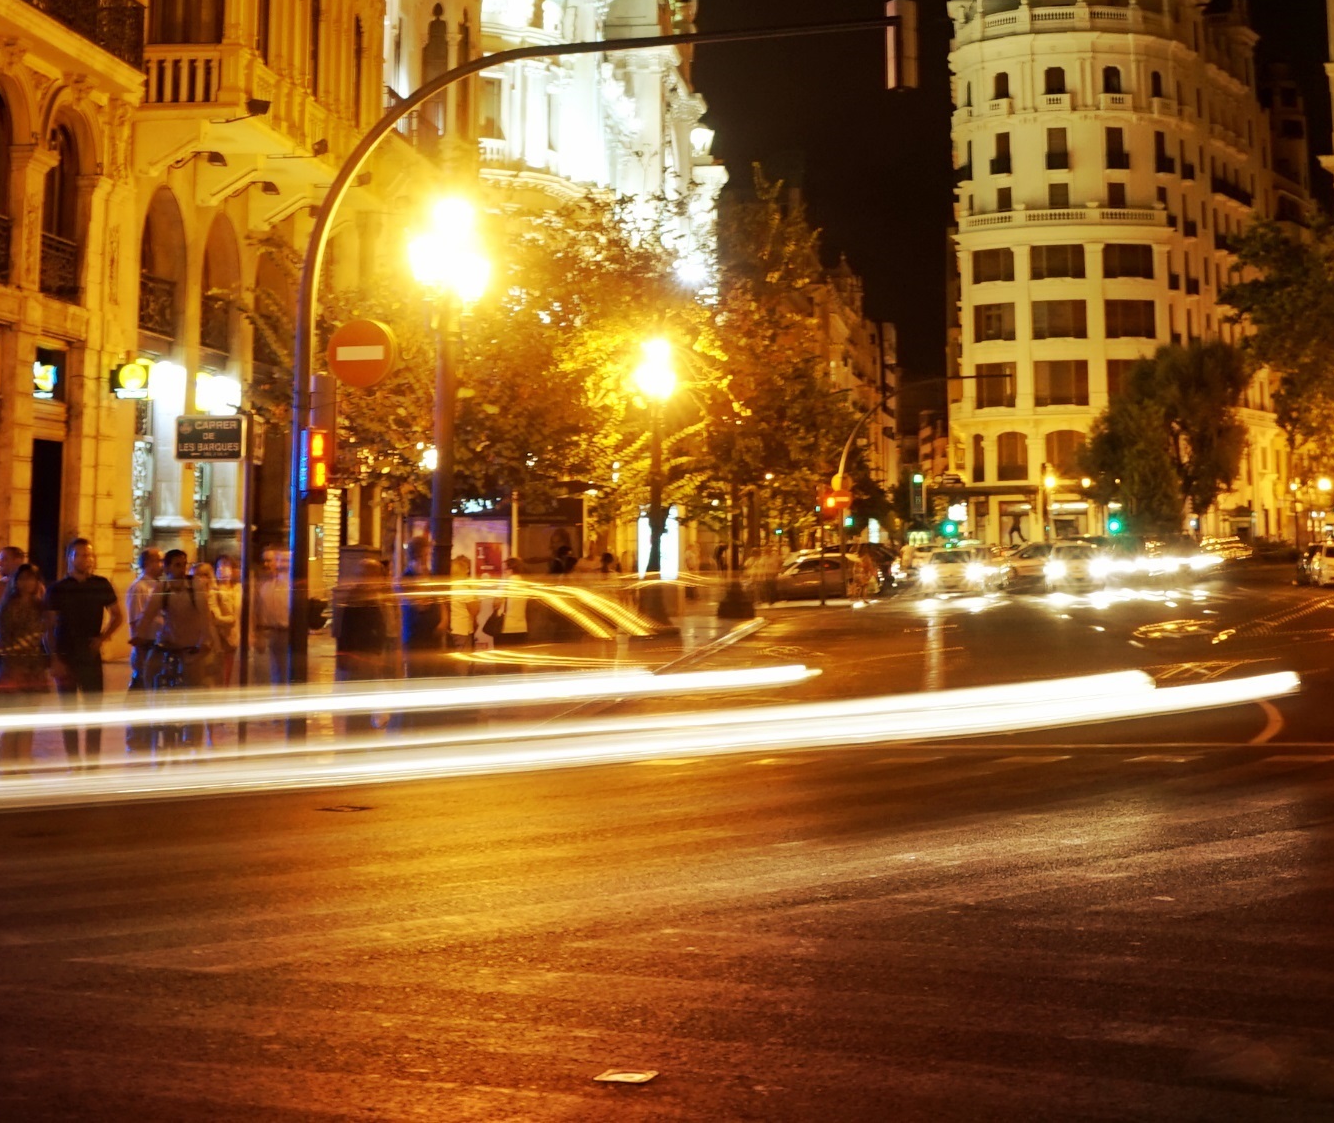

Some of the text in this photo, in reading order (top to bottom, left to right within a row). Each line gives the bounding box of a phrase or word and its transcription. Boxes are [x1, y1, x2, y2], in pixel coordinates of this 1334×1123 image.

[195, 420, 238, 430] CARRER
[203, 432, 215, 440] DE
[179, 443, 239, 452] LES BARQUES
